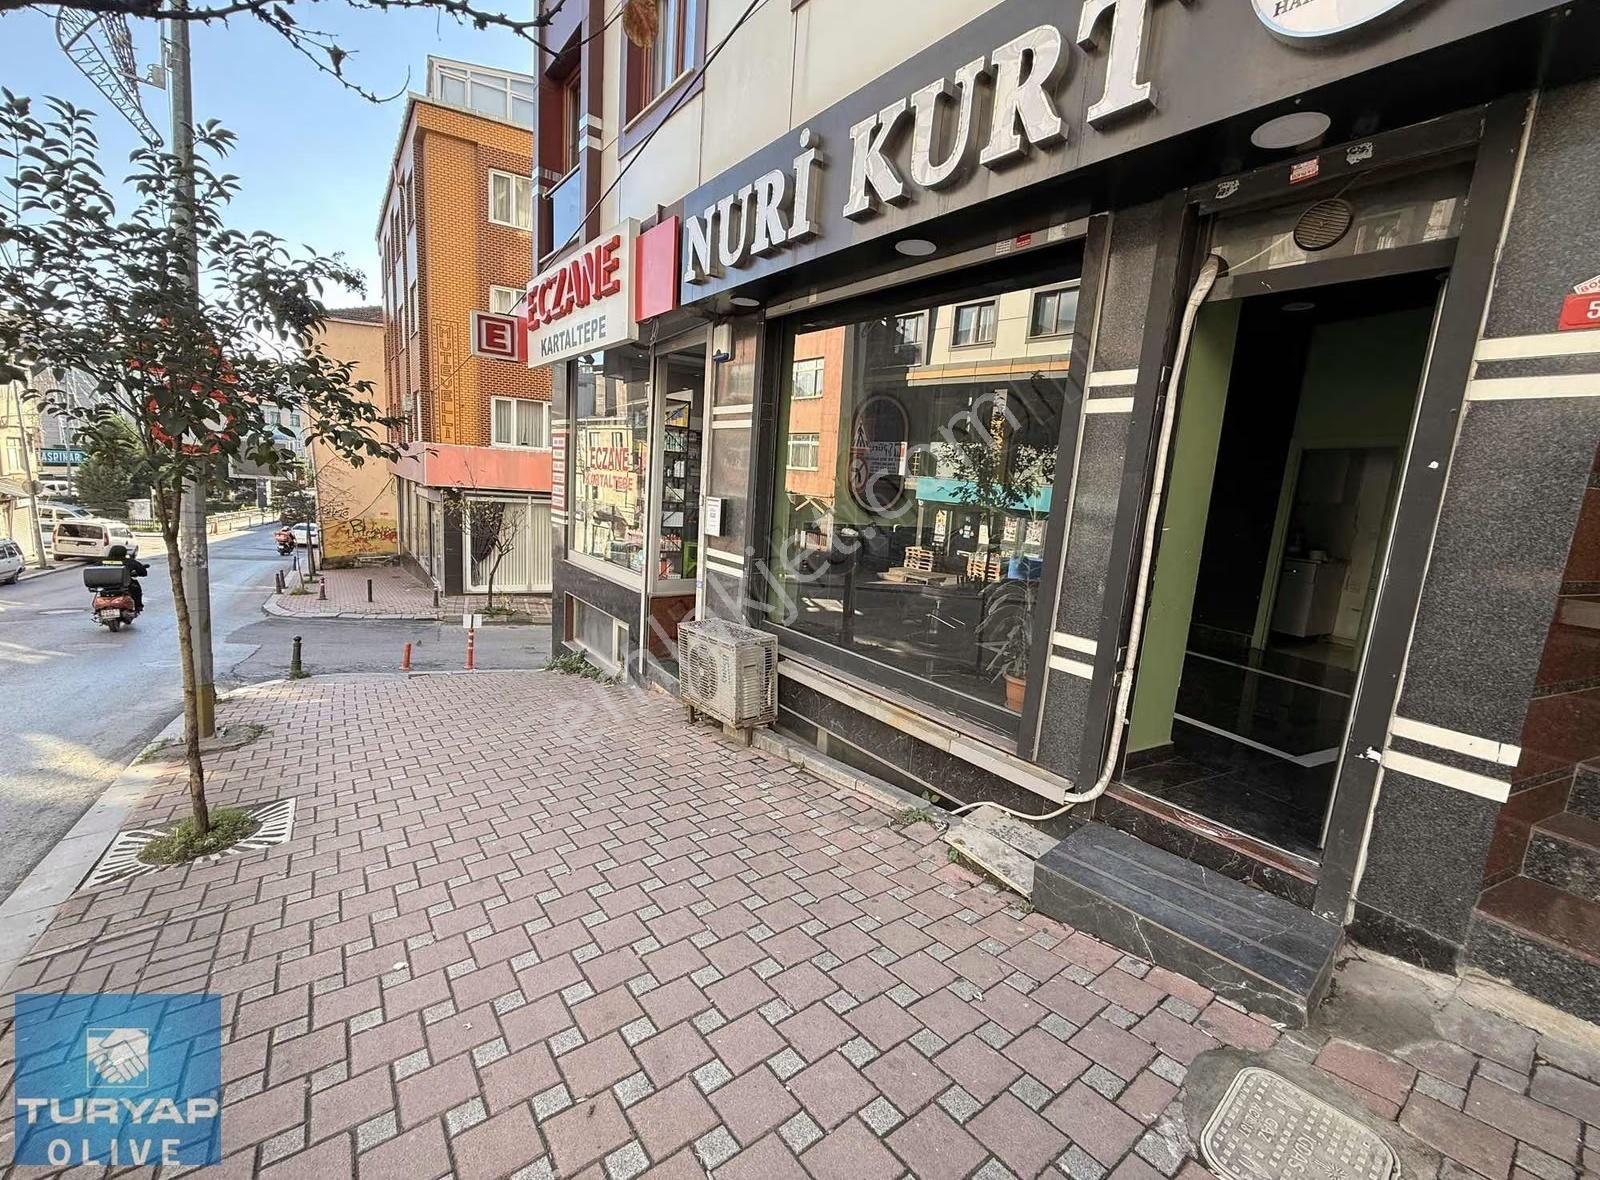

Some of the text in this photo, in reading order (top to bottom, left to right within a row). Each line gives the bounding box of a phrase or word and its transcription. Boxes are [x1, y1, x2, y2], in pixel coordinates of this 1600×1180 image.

[684, 0, 1157, 283] NURİ KURT
[528, 235, 621, 332] ECZANE
[485, 322, 507, 350] E
[540, 315, 607, 357] KARTALTEPE
[590, 447, 629, 471] ECZANE
[1258, 1117, 1279, 1143] GAZ
